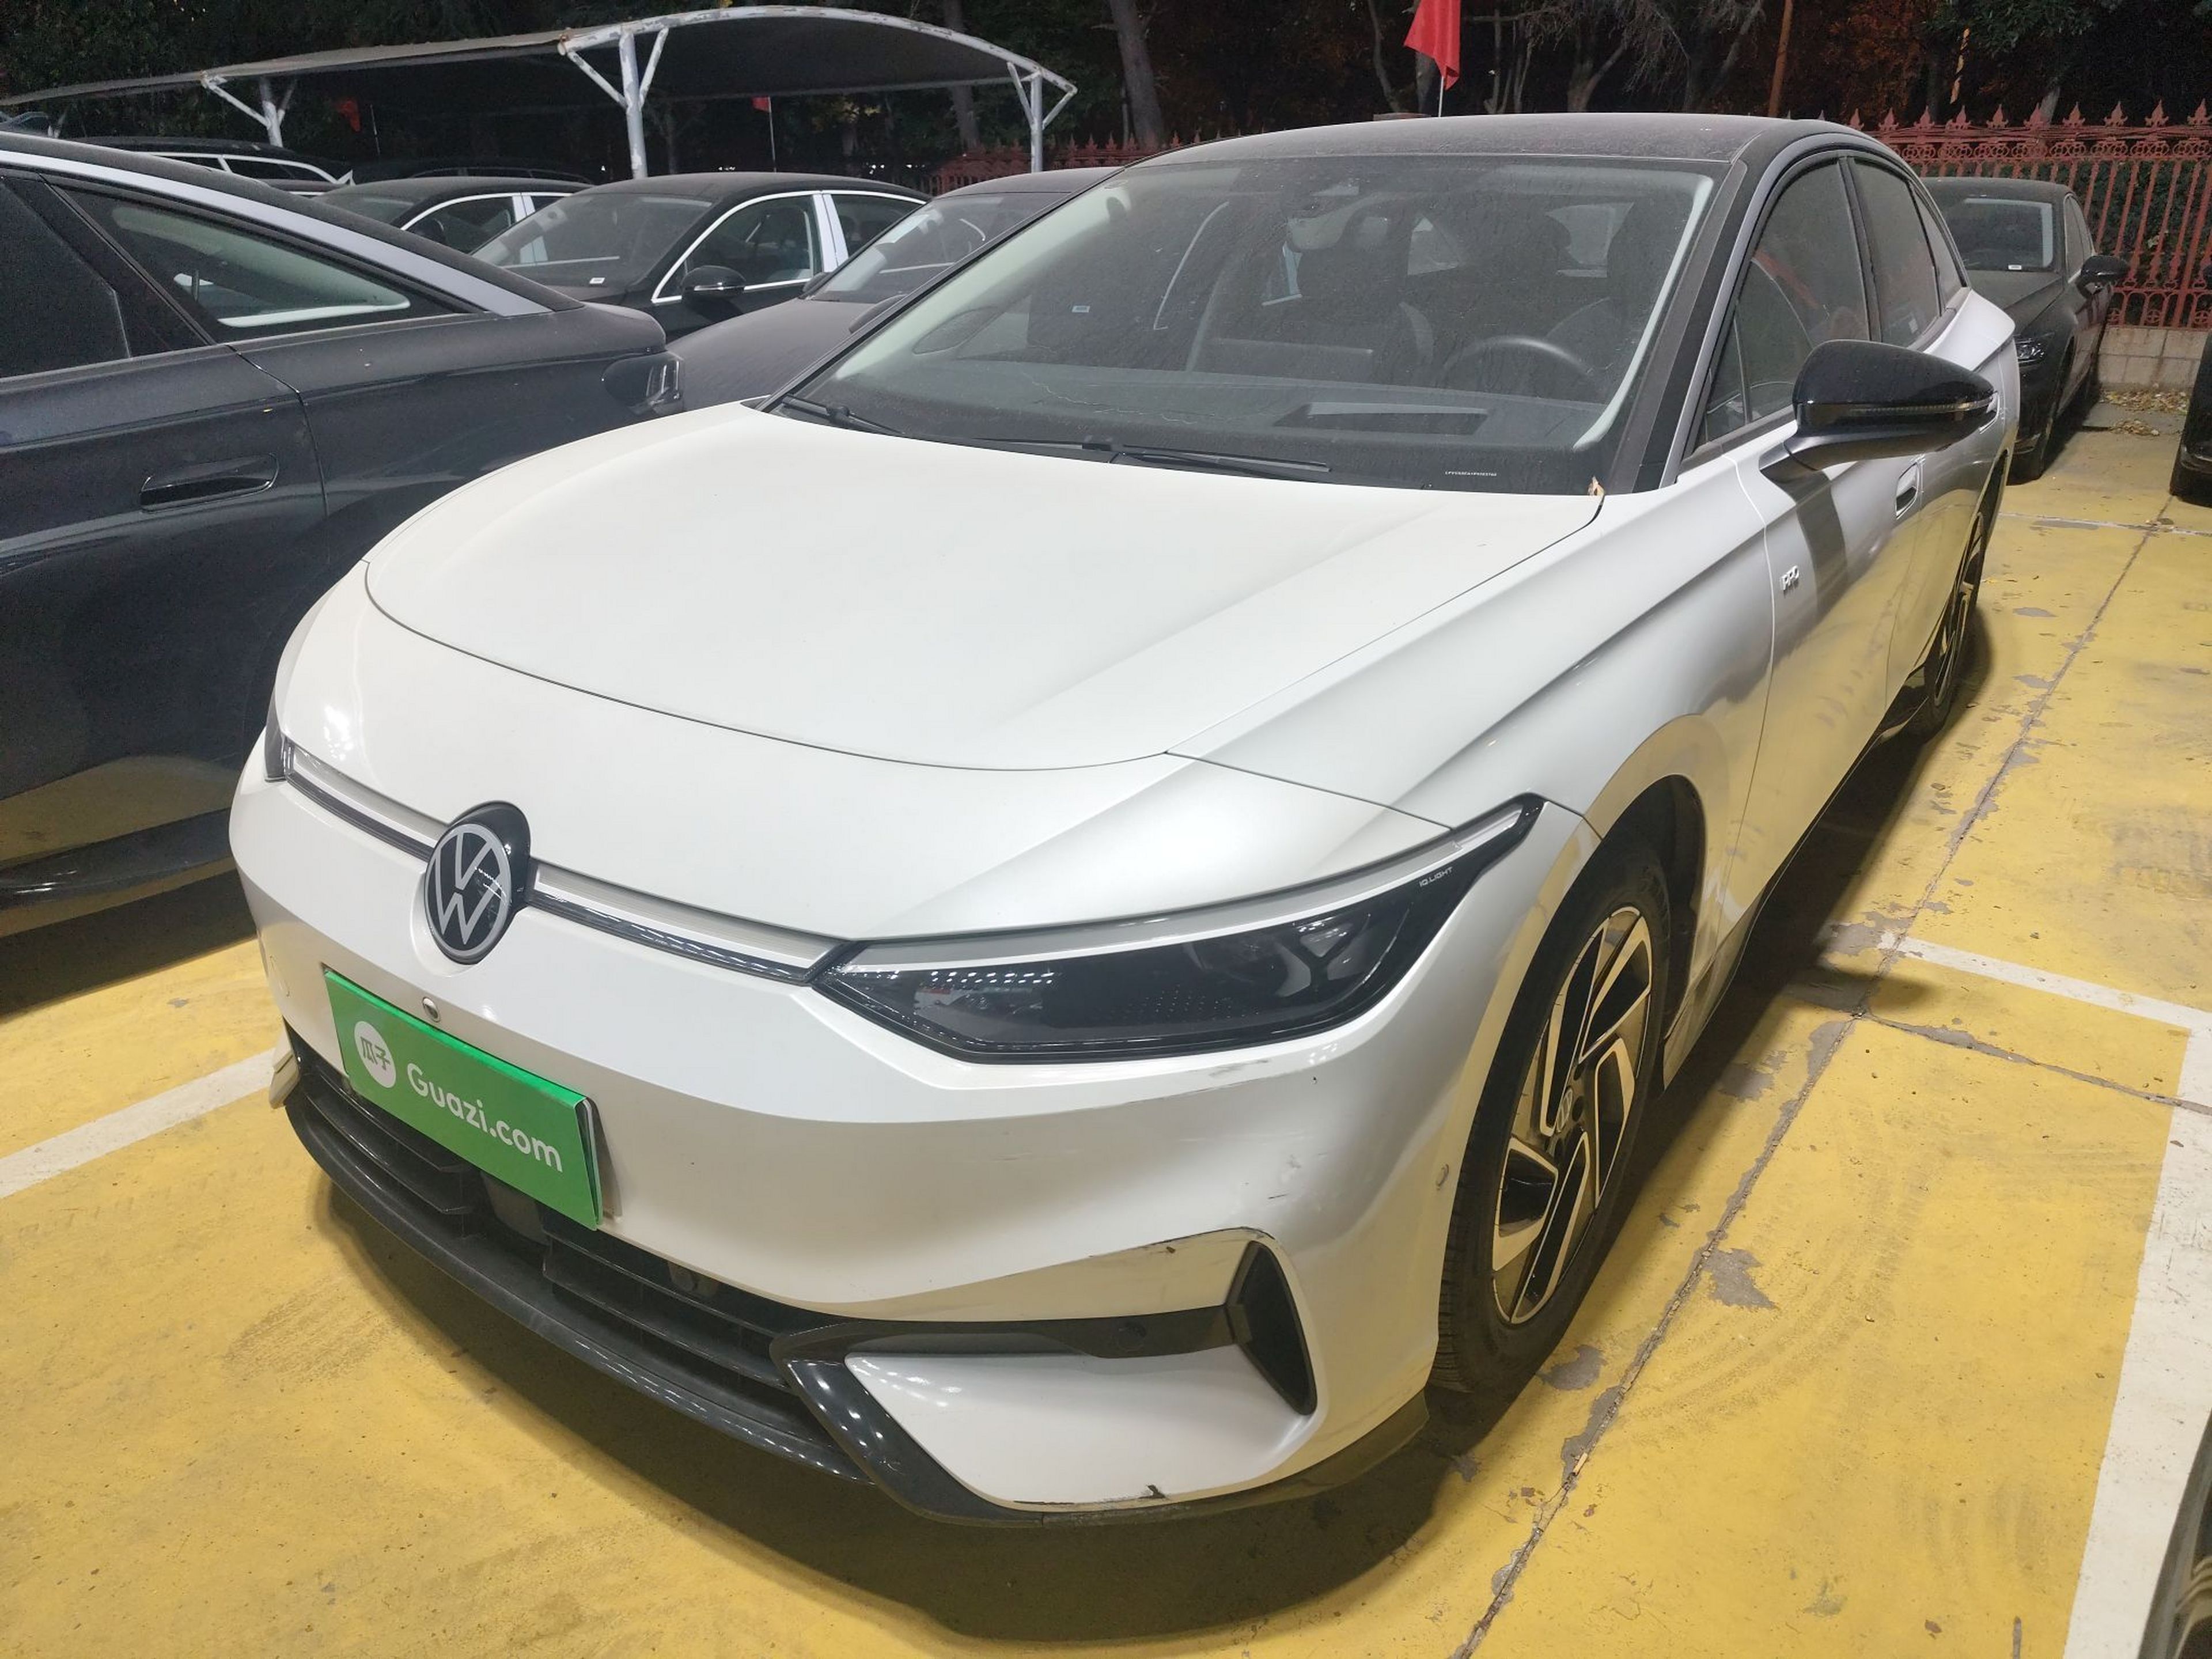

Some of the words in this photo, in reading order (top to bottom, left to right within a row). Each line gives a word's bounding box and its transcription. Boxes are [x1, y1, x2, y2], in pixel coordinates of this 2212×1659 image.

[431, 827, 505, 948] VW
[360, 1037, 391, 1071] 瓜子
[407, 1063, 563, 1173] Guazi.com
